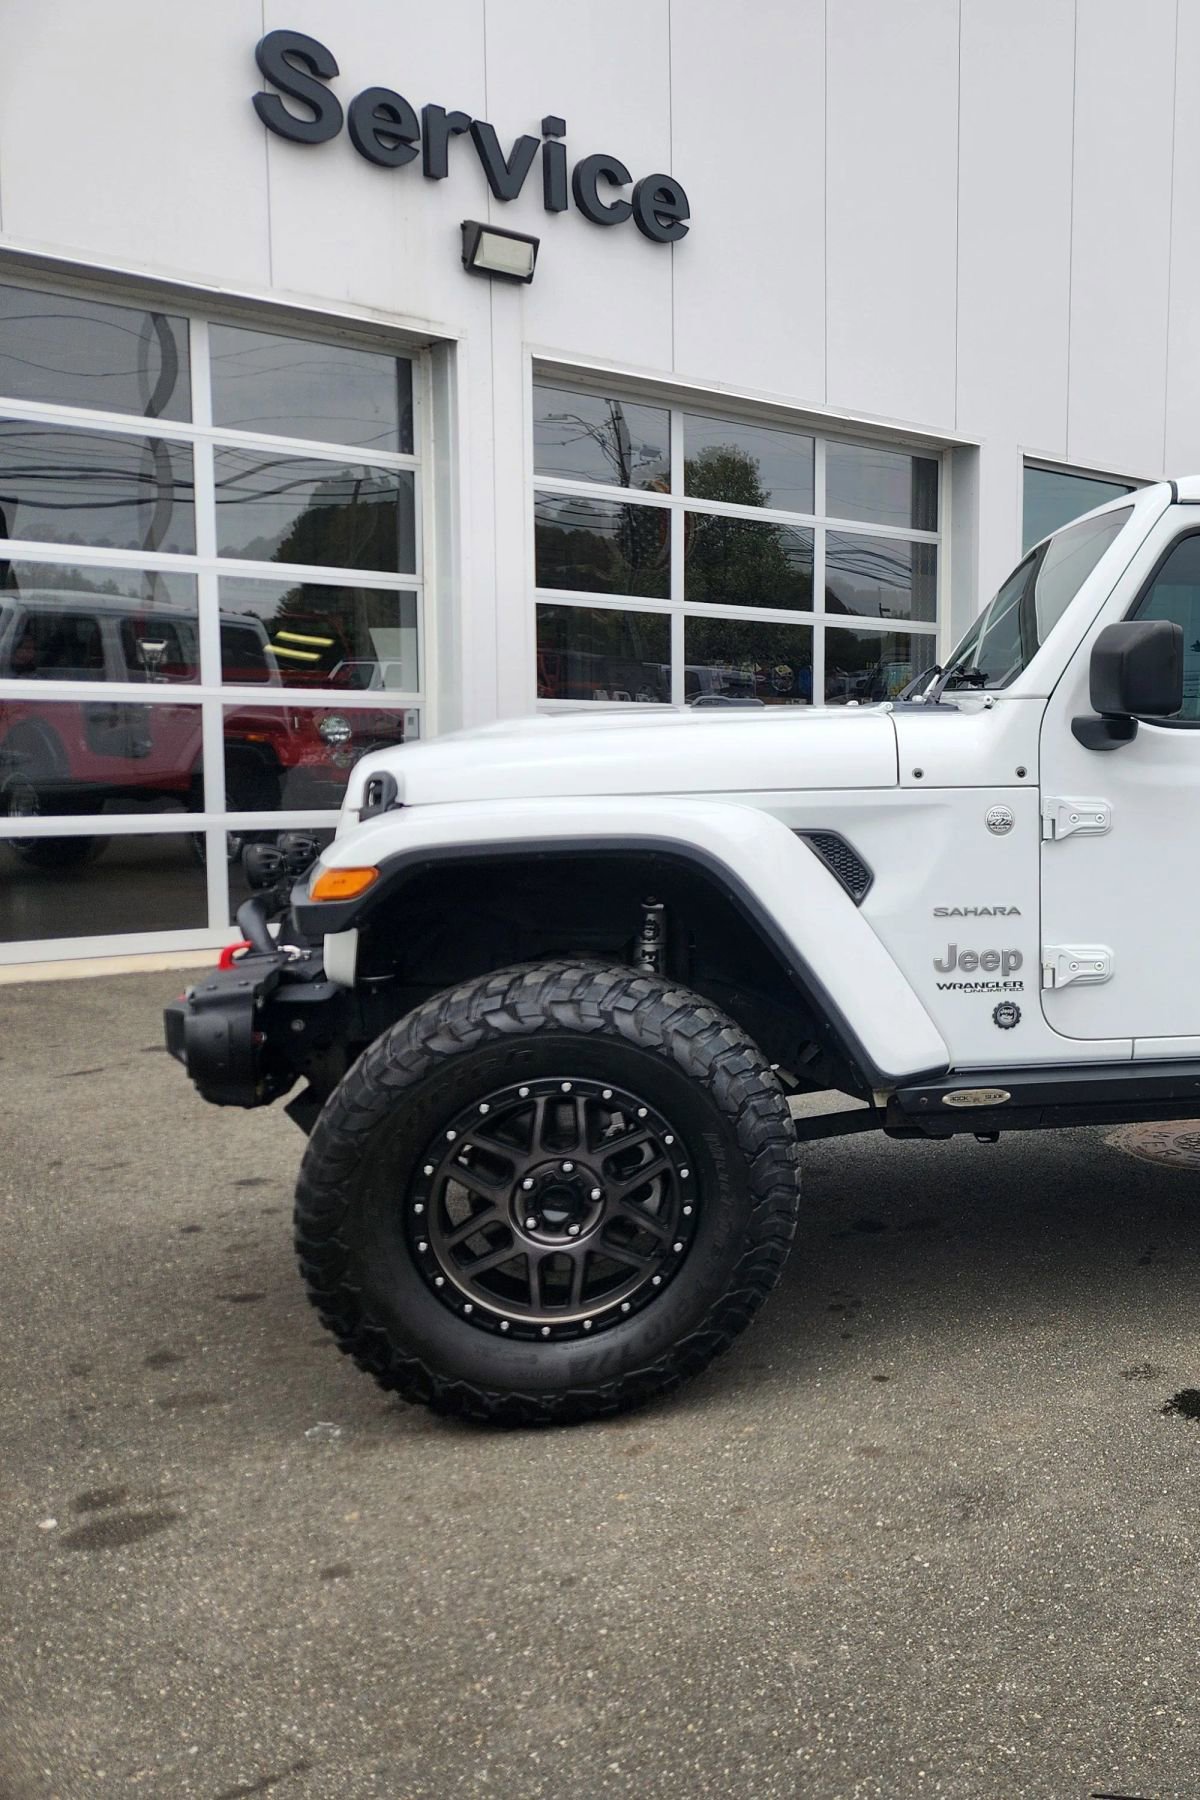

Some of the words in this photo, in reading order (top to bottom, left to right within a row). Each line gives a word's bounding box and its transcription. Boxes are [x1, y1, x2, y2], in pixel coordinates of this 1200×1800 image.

[252, 29, 691, 243] Service
[933, 906, 1021, 917] SAHARA
[933, 943, 1023, 976] Jeep
[936, 981, 1024, 991] WRANGLER
